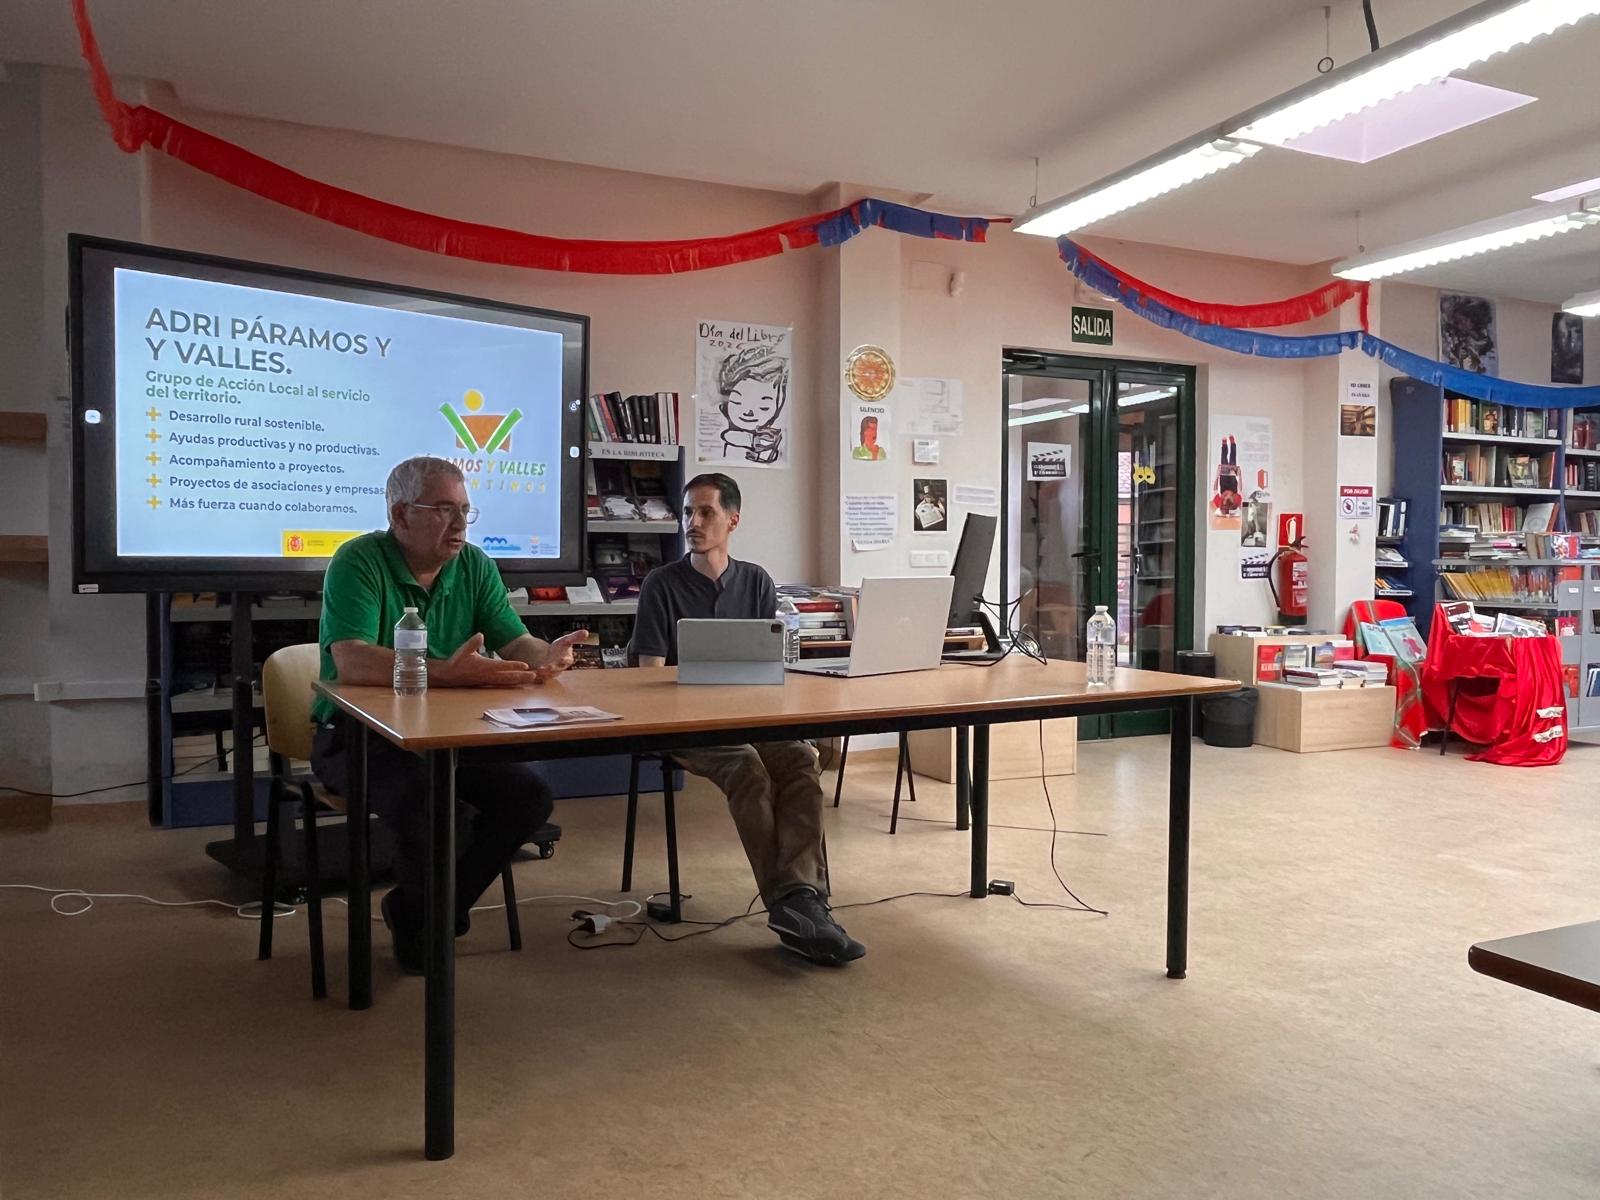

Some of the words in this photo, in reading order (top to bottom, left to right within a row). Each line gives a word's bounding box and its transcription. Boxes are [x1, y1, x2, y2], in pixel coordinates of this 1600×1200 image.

[145, 307, 219, 337] ADRI
[231, 315, 368, 355] PÁRAMOS
[375, 336, 392, 357] Y
[729, 327, 743, 341] del
[747, 327, 786, 345] Libro
[1073, 315, 1111, 337] SALIDA
[145, 337, 167, 361] Y
[174, 340, 293, 375] VALLES.
[145, 370, 192, 387] Grupo
[195, 374, 214, 388] de
[218, 376, 265, 393] Acción
[269, 382, 303, 396] Local
[306, 385, 319, 398] al
[321, 386, 370, 403] servicio
[145, 384, 169, 398] del
[172, 386, 242, 405] territorio.
[859, 406, 885, 414] SILENCIO
[169, 410, 232, 425] Desarrollo
[234, 415, 262, 427] rural
[264, 418, 325, 432] sostenible.
[169, 432, 215, 445] Ayudas
[217, 436, 286, 450] productivas
[288, 441, 296, 452] y
[298, 442, 312, 452] no
[315, 442, 380, 457] productivas.
[169, 454, 276, 471] Acompañamiento
[278, 462, 286, 471] a
[288, 461, 345, 474] proyectos.
[487, 460, 498, 473] Y
[499, 461, 547, 476] VALLES
[169, 476, 231, 490] Proyectos
[233, 478, 248, 490] de
[251, 480, 323, 493] asociaciones
[325, 484, 332, 495] y
[169, 497, 196, 509] Más
[198, 498, 236, 511] fuerza
[238, 500, 282, 512] cuando
[284, 501, 358, 514] colaboramos.
